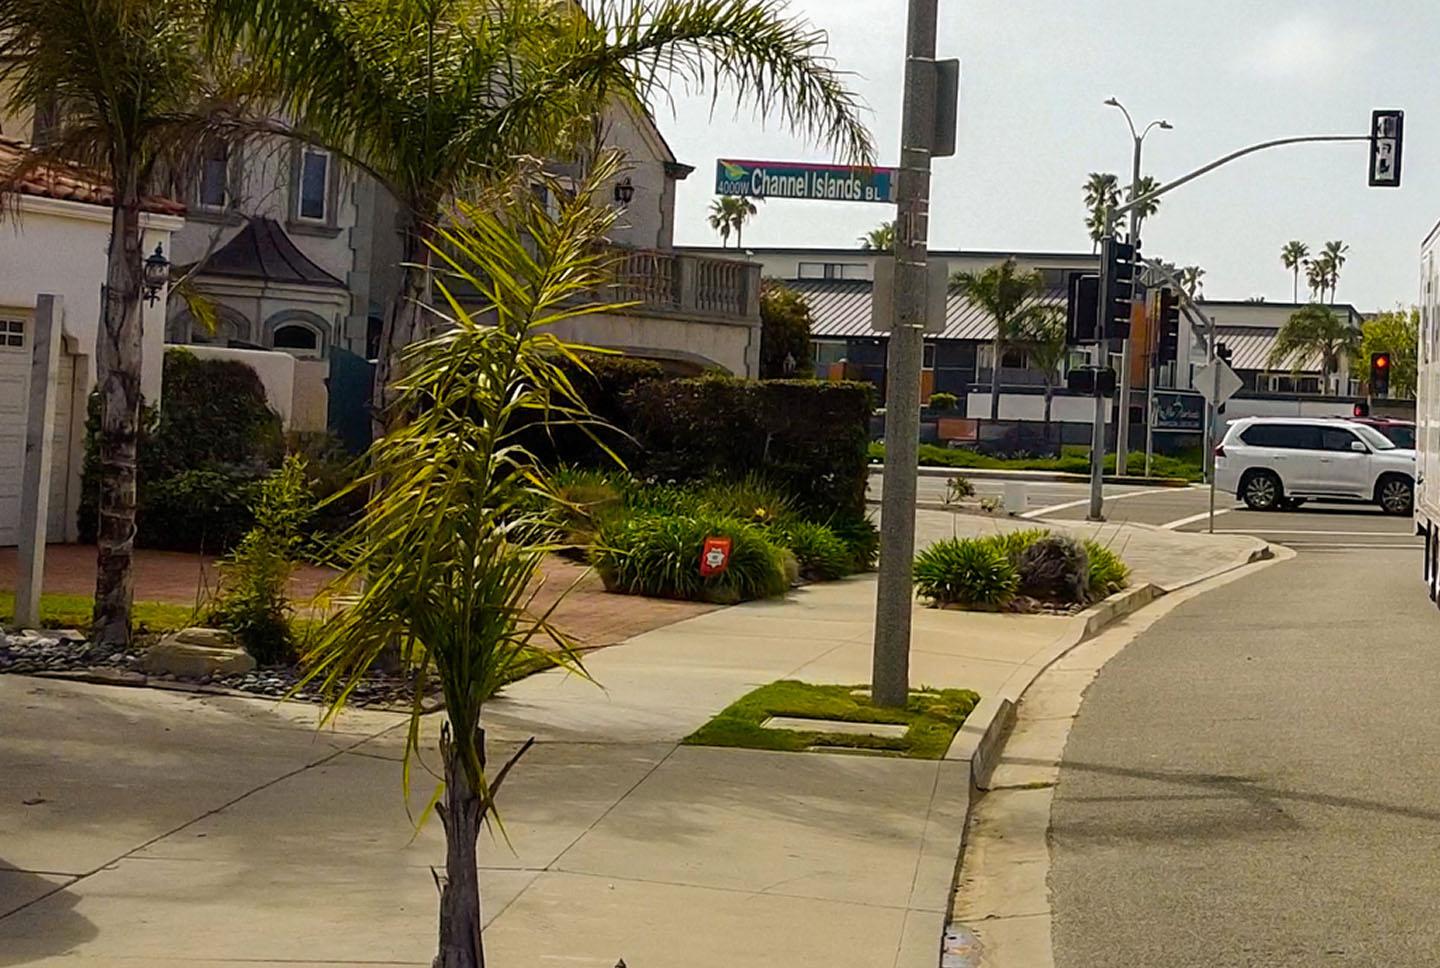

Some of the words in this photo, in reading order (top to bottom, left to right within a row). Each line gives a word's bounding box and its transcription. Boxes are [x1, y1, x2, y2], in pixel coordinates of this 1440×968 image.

[719, 180, 750, 195] 4000W
[751, 168, 809, 197] Channel
[812, 171, 862, 200] Islands
[865, 186, 882, 201] BL
